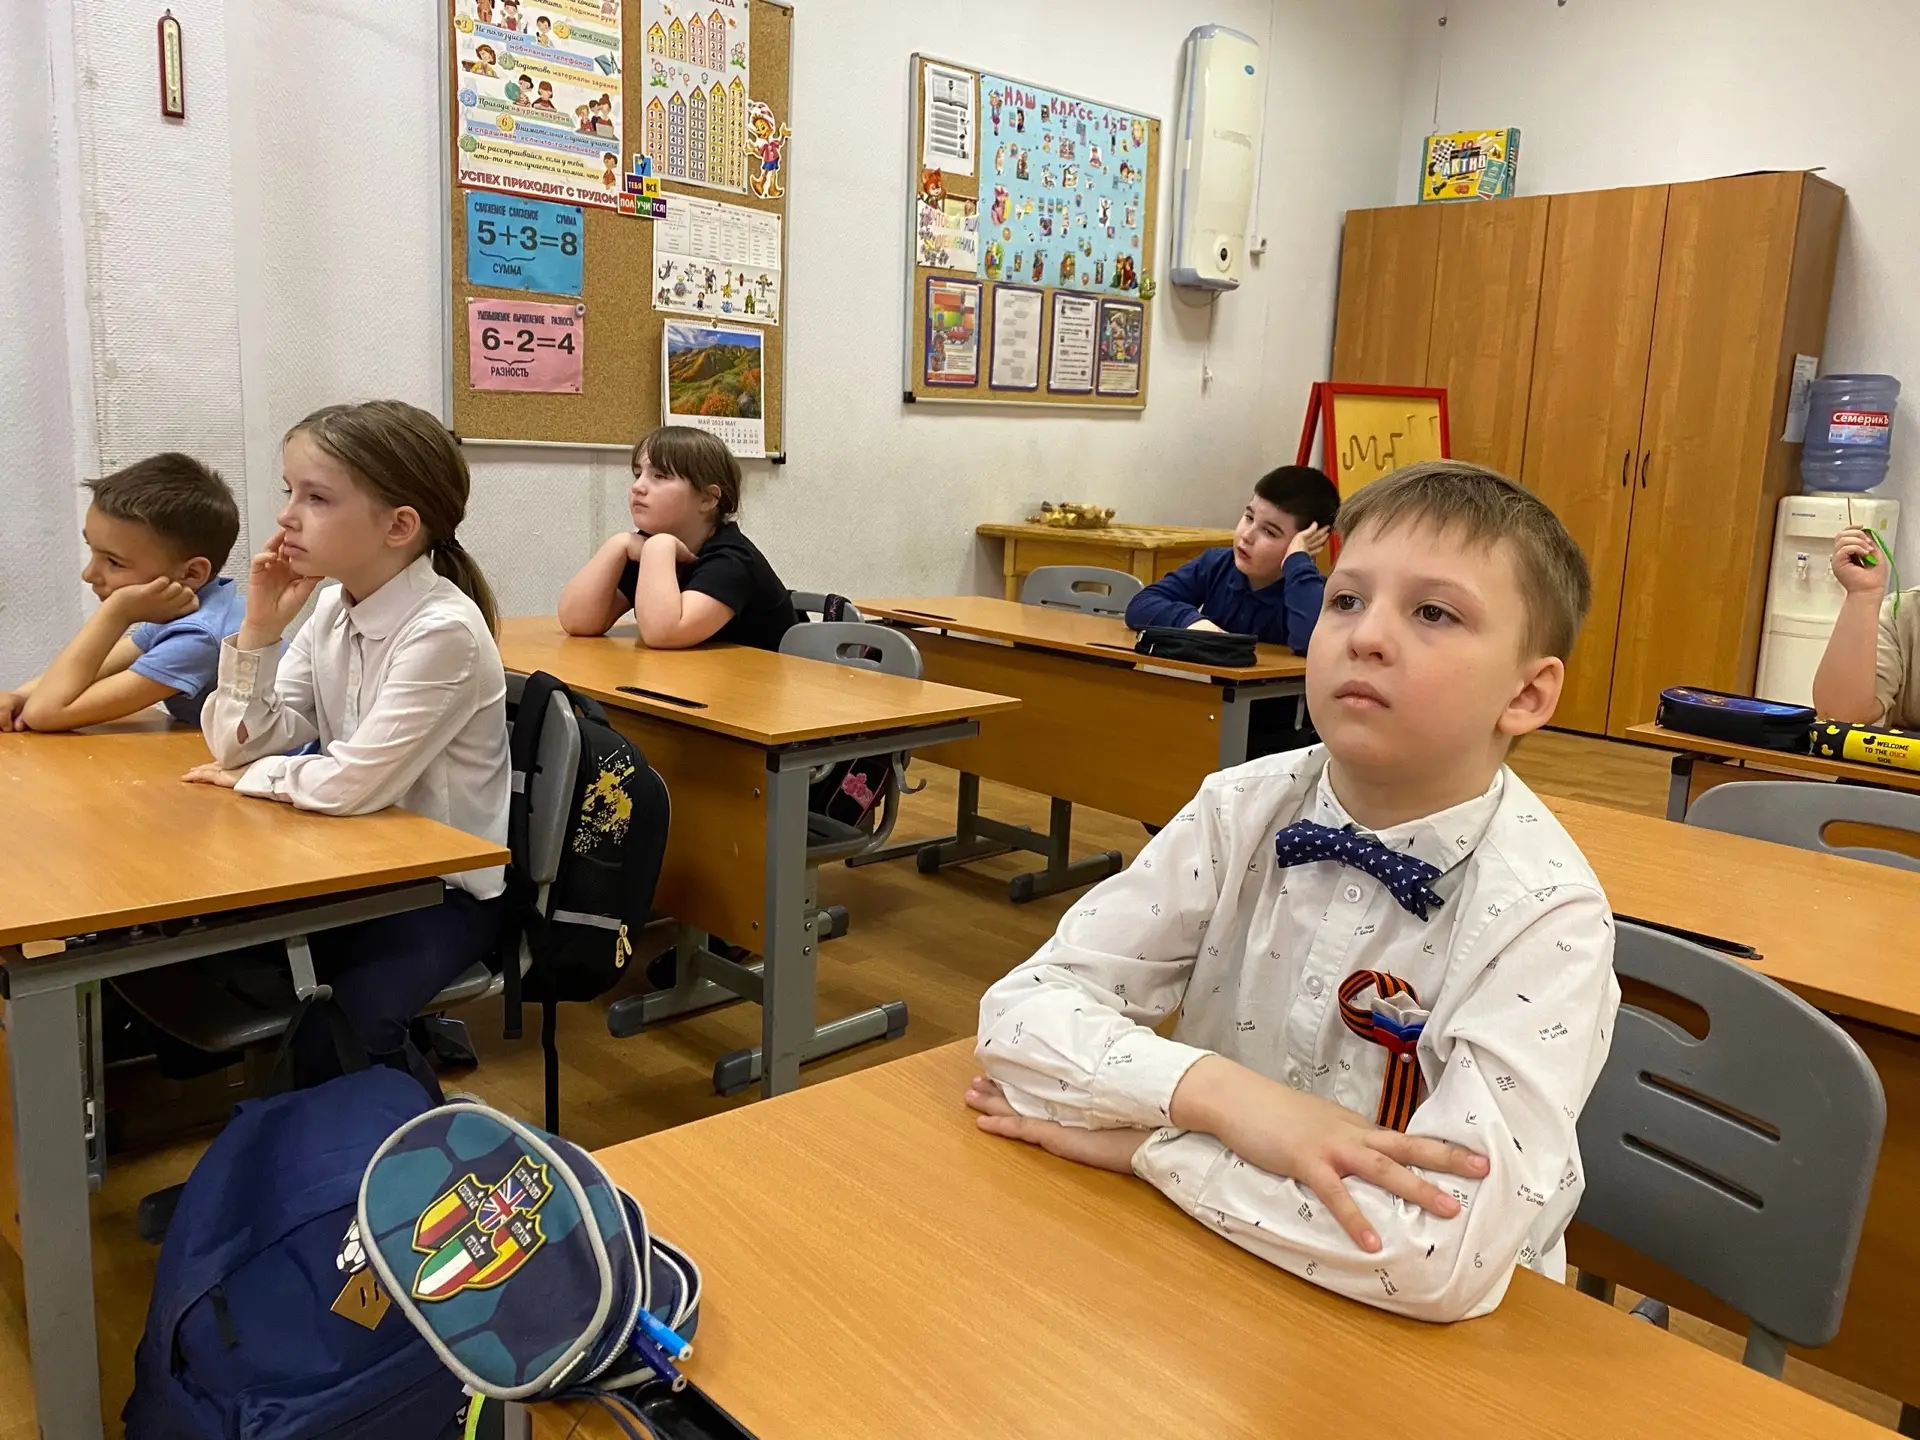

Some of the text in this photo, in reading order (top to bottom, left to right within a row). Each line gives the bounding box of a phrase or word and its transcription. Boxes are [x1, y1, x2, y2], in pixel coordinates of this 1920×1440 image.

[600, 13, 617, 25] руку
[1004, 86, 1036, 110] НАШ
[1050, 97, 1094, 122] КЛАСС
[546, 156, 560, 164] если
[460, 169, 618, 206] УСПЕХ ПРИХОДИТ С ТРУДОМ
[628, 181, 642, 190] ТЕБЯ
[556, 214, 577, 226] СУММА
[477, 220, 578, 256] 5+3=8
[492, 262, 522, 276] СУММА
[551, 316, 574, 326] РАЗНОСТЬ
[482, 326, 575, 355] 6-2=4
[490, 366, 530, 378] РАЗНОСТЬ
[1833, 412, 1888, 426] Семерикъ
[1877, 741, 1909, 751] WELCOME
[464, 1234, 486, 1259] ITALY
